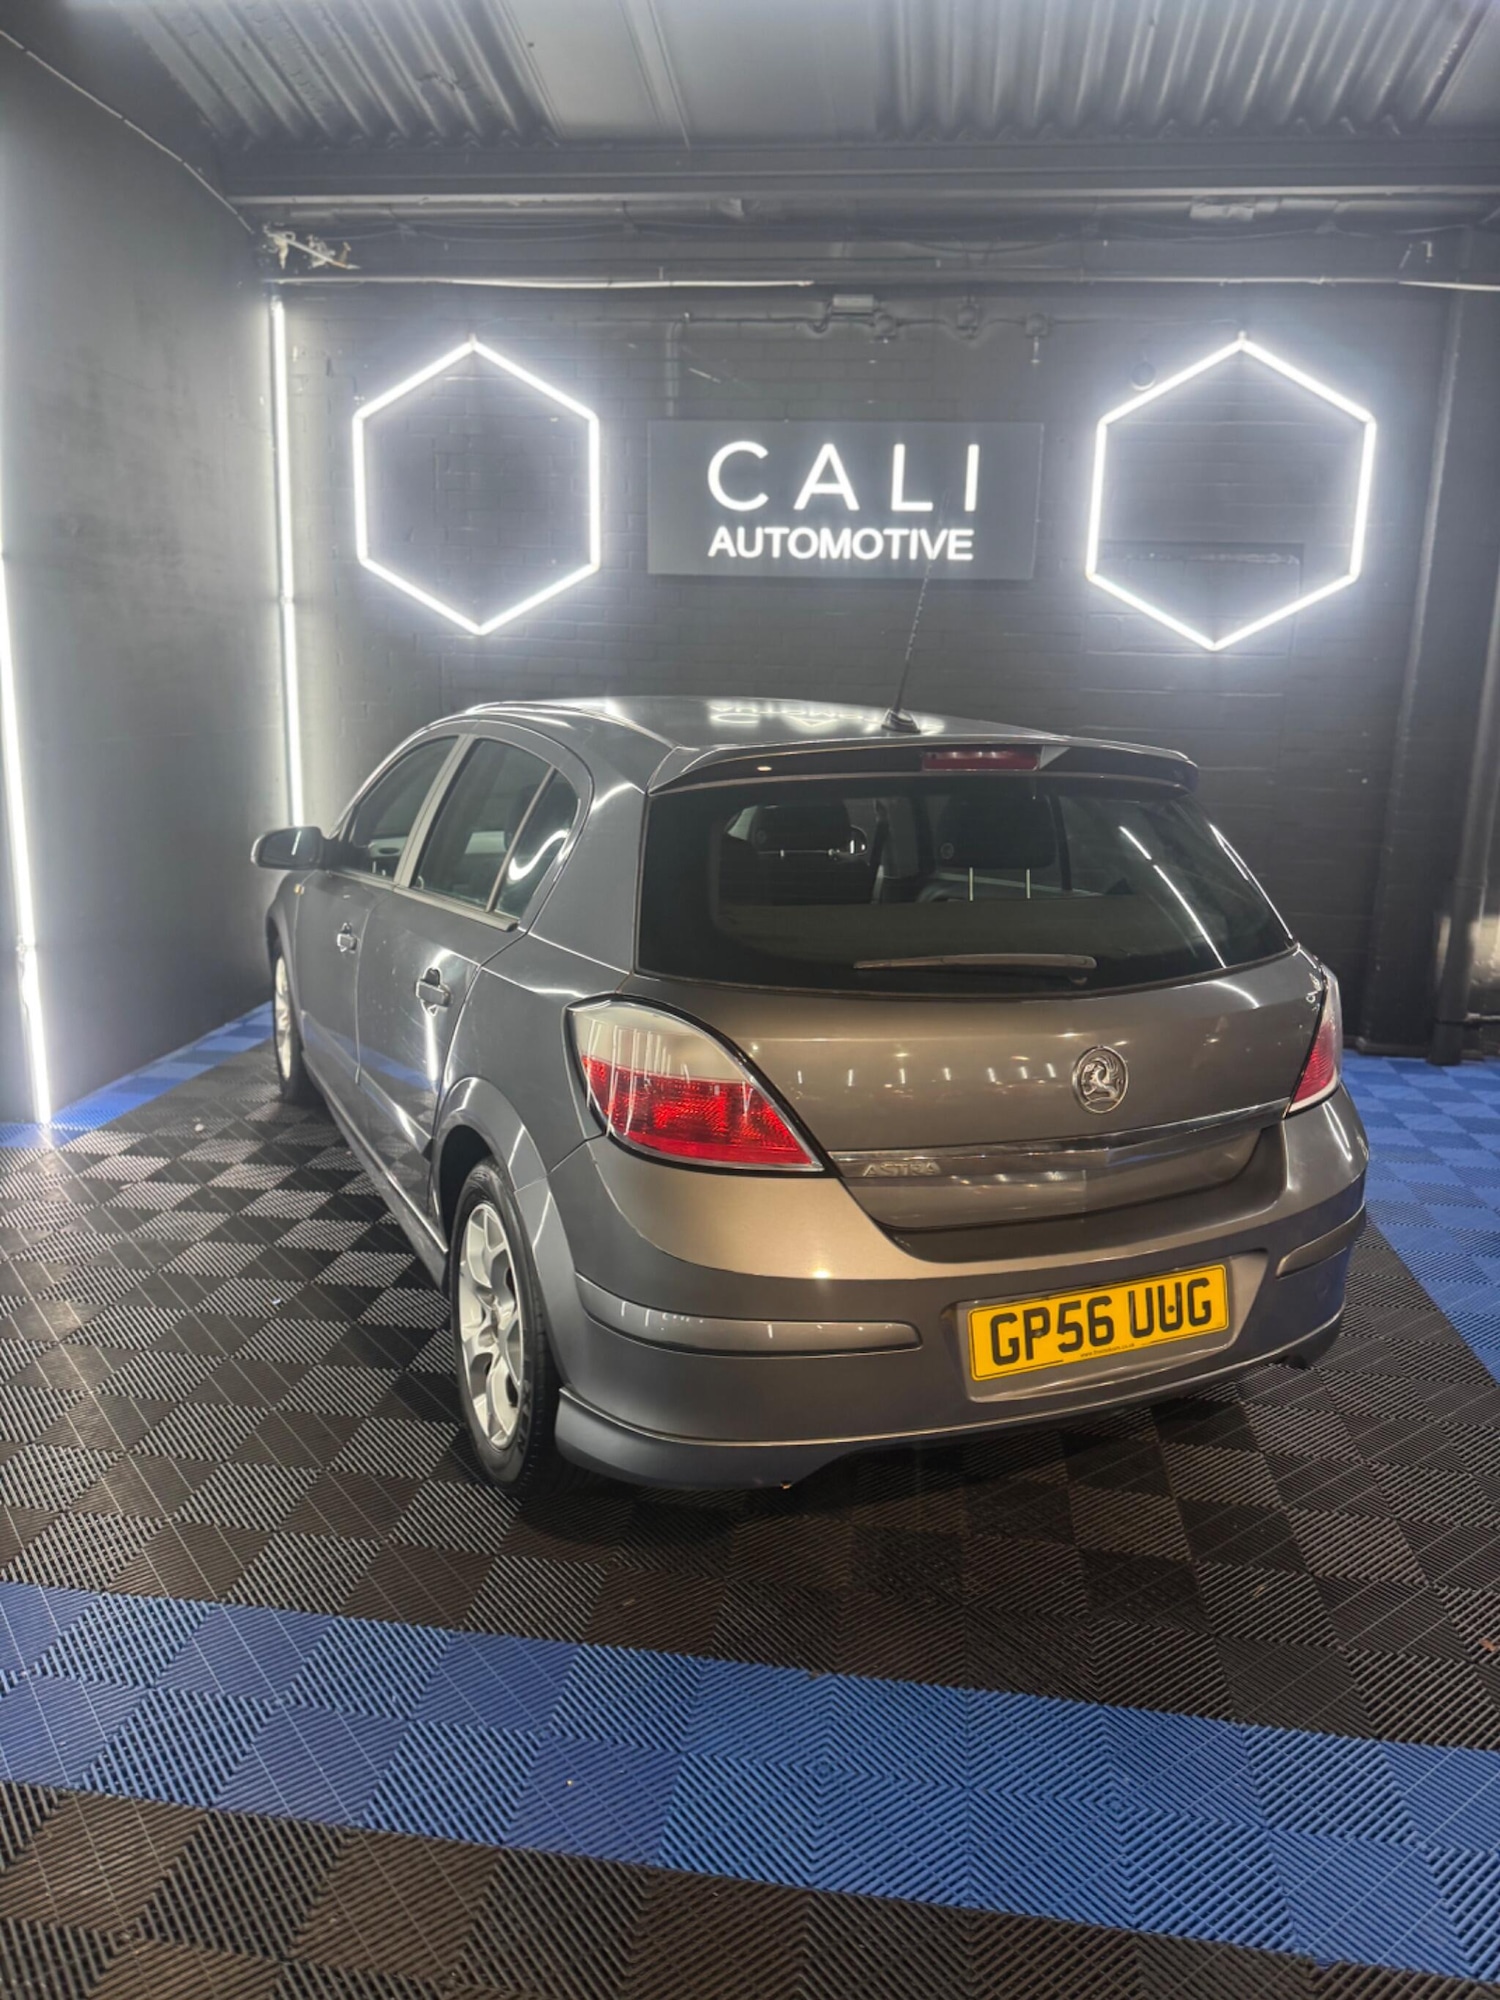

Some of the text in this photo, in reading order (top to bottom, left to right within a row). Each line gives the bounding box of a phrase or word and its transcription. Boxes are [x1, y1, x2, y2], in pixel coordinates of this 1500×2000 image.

[707, 440, 980, 512] CALI
[707, 525, 975, 561] AUTOMOTIVE
[862, 1161, 941, 1177] ASTRA
[990, 1277, 1212, 1366] GP56 UUG
